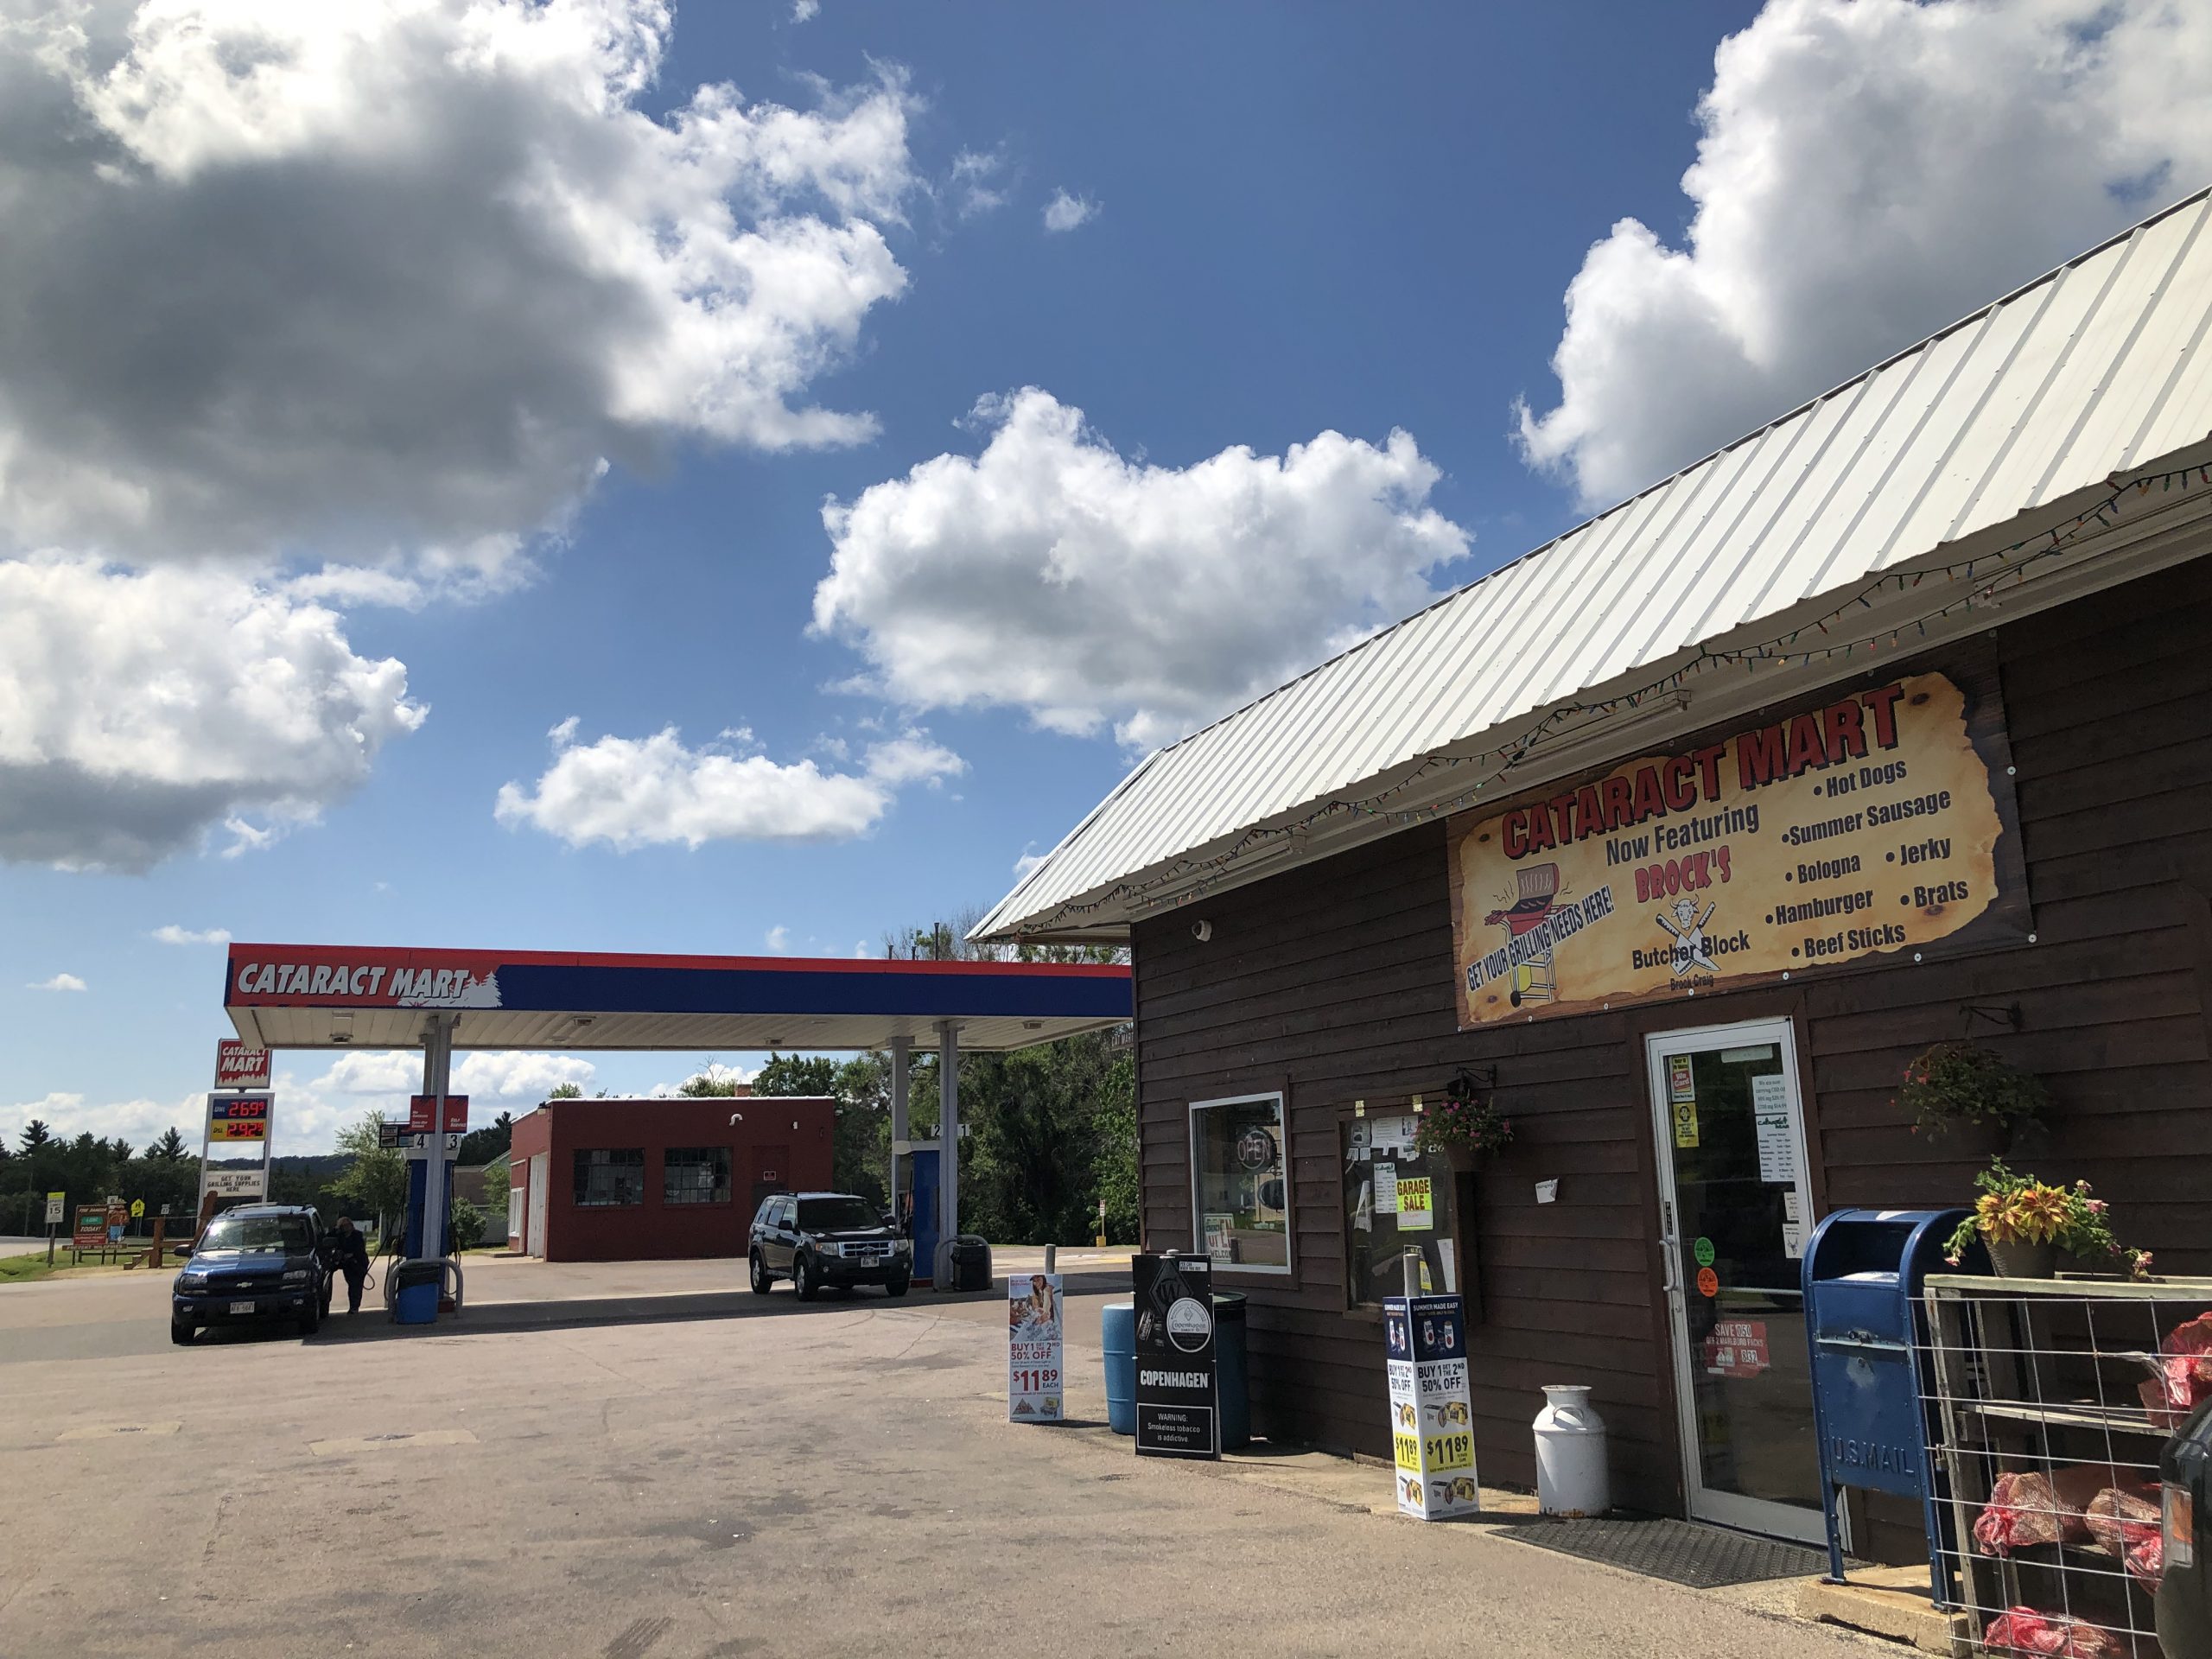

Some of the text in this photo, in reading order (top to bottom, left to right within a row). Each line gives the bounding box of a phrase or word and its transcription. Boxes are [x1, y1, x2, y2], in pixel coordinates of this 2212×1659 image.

[1502, 683, 1905, 860] CATARACT MART
[1827, 760, 1907, 798] Hot Dogs
[1789, 791, 1951, 846] Summer Sausage
[1606, 804, 1759, 867] Now Featuring
[1901, 837, 1951, 867] Jerky
[1635, 845, 1732, 903] BROCK'S
[1797, 855, 1861, 884] Bologna
[1914, 880, 1969, 907] Brats
[1776, 889, 1873, 925] Hamburger
[1466, 885, 1615, 992] GET YOUR GRILLING NEEDS HERE!
[1804, 924, 1906, 958] Beef Sticks
[1632, 930, 1751, 969] Butcher Block
[238, 963, 471, 999] CATARACT MART
[221, 1057, 264, 1071] MART
[934, 1124, 940, 1136] 2
[962, 1124, 966, 1137] 1
[416, 1135, 424, 1148] 4
[450, 1135, 458, 1148] 3
[1237, 1138, 1271, 1161] OPEN
[1396, 1179, 1430, 1196] GARAGE
[1403, 1195, 1425, 1211] SALE
[1173, 1320, 1206, 1330] Copenhagen
[1714, 1324, 1735, 1337] SAVE
[1011, 1343, 1030, 1351] BUY
[1046, 1342, 1060, 1351] 2ND
[1719, 1338, 1746, 1346] MARLBORO
[1011, 1351, 1052, 1361] 50% OFF
[1389, 1364, 1398, 1376] BUY
[1418, 1366, 1436, 1378] BUY
[1437, 1365, 1442, 1376] 1
[1452, 1363, 1465, 1376] 2ND
[1141, 1370, 1209, 1388] COPENHAGEN
[1391, 1378, 1411, 1392] 50% OFF
[1422, 1377, 1461, 1392] 50% OFF
[1158, 1414, 1188, 1422] WARNING:
[1147, 1422, 1200, 1433] Smokeless tobacco
[1863, 1441, 1915, 1475] MAIL
